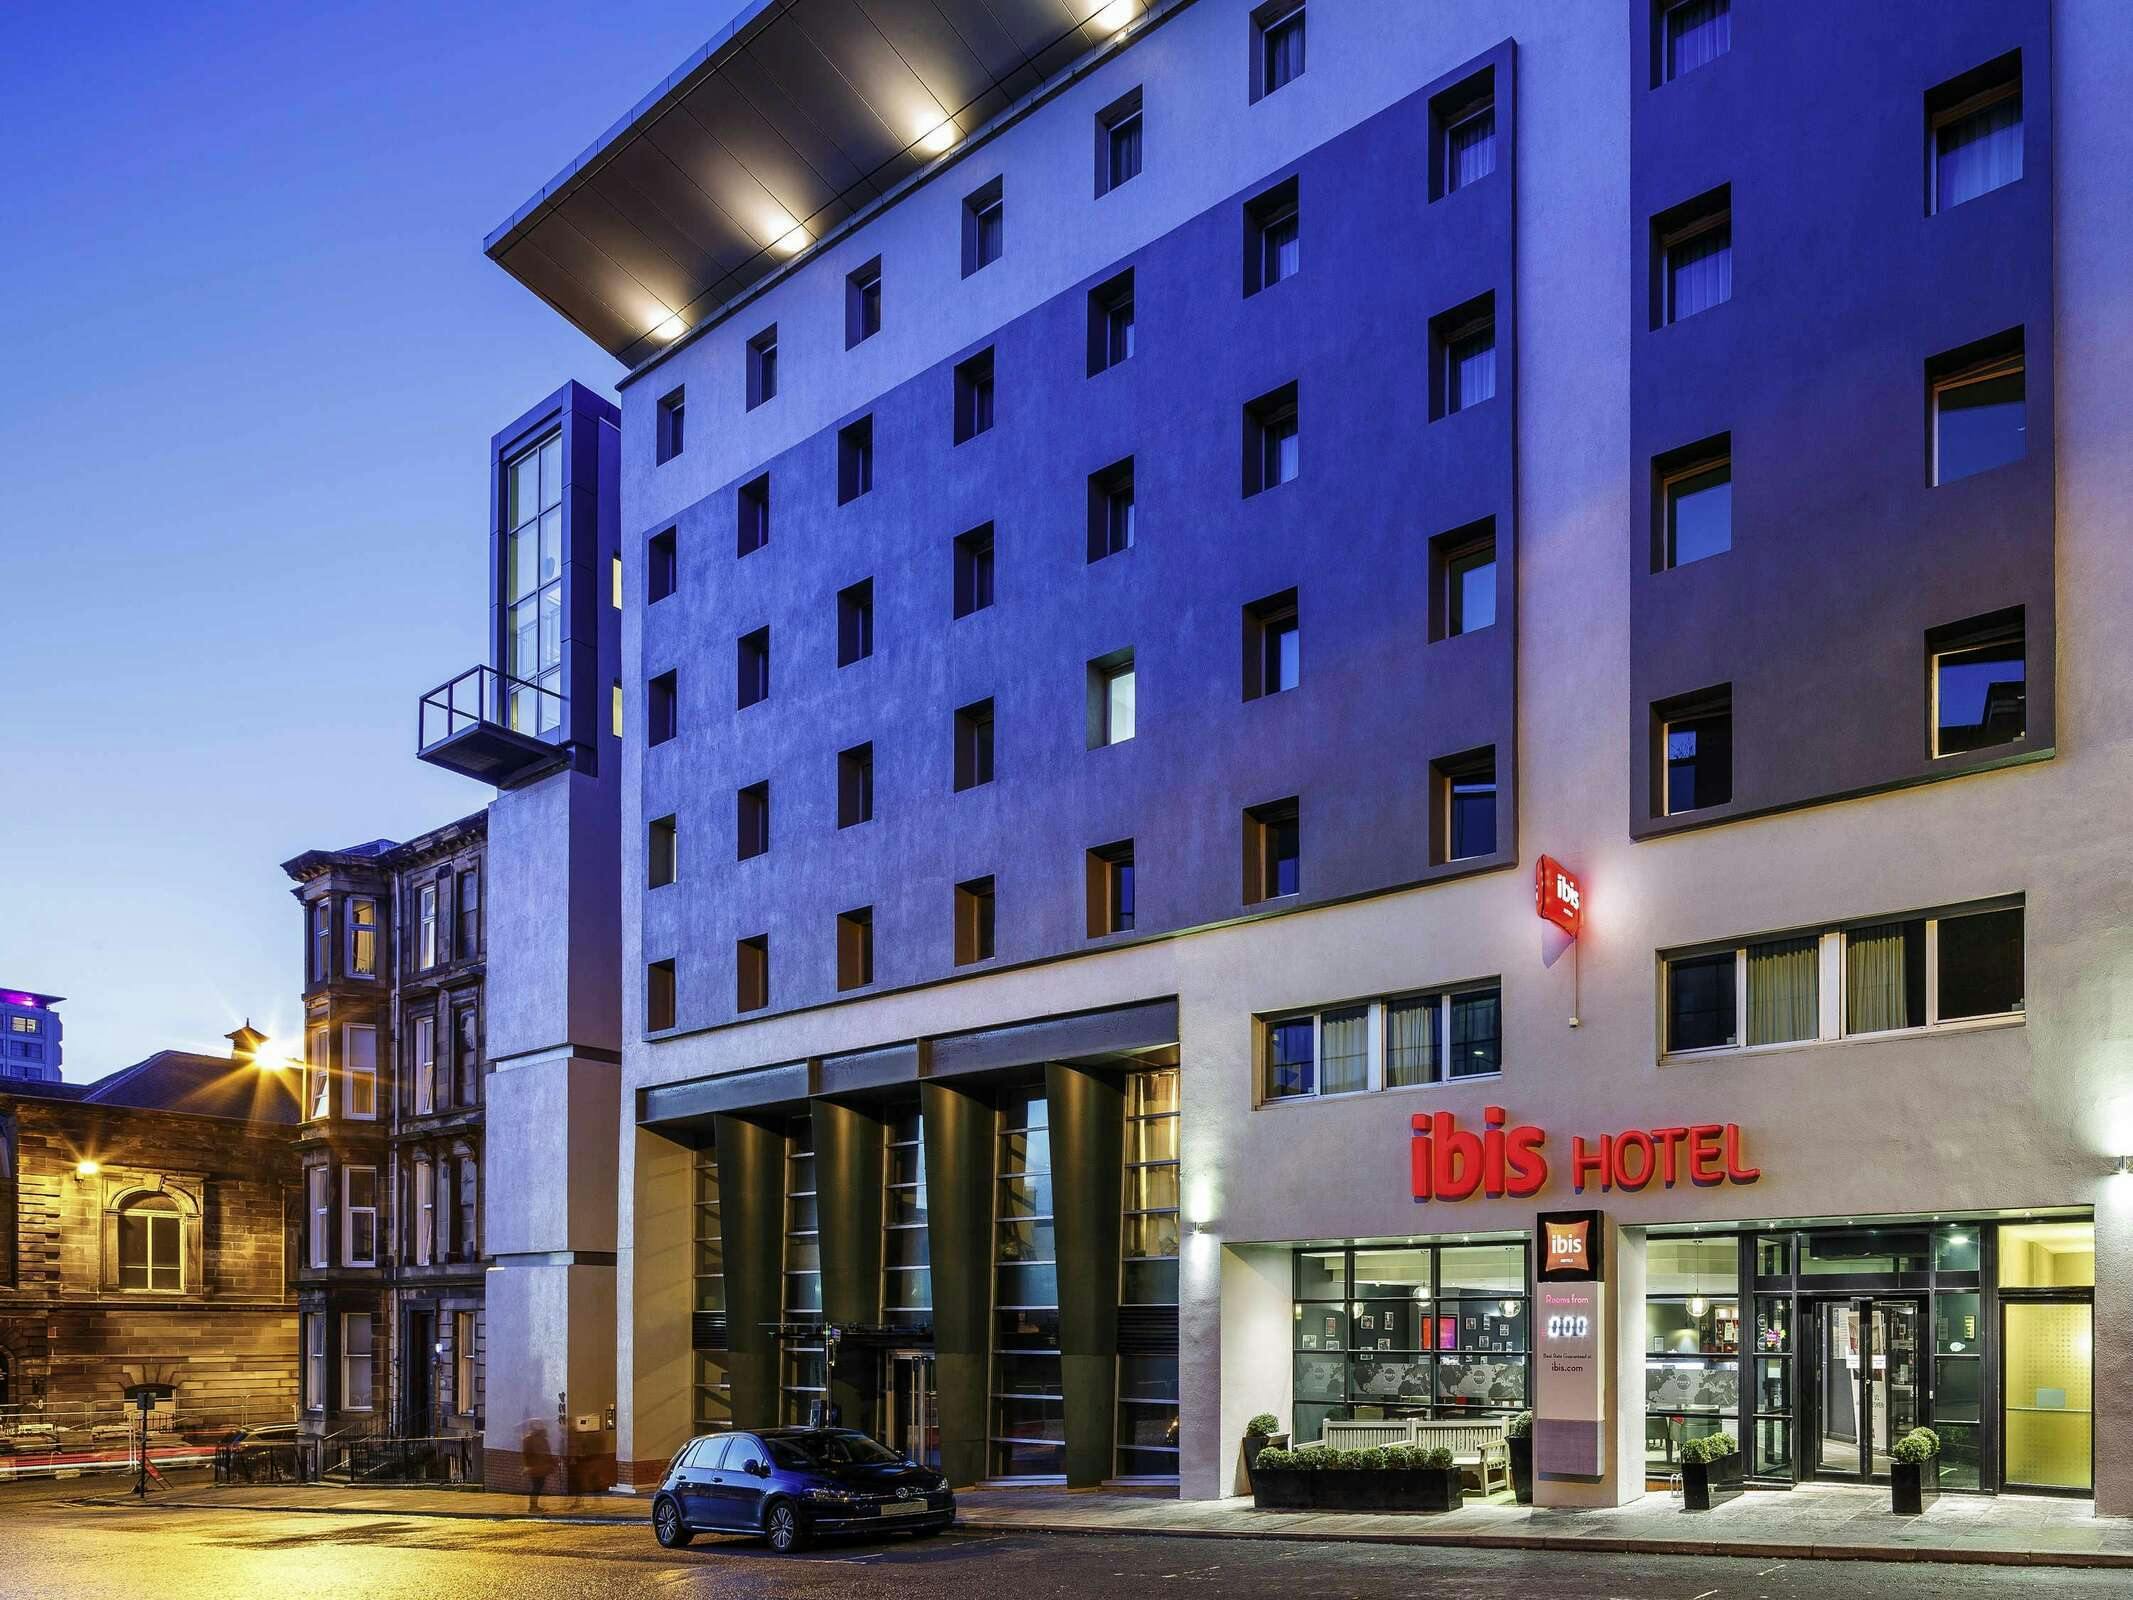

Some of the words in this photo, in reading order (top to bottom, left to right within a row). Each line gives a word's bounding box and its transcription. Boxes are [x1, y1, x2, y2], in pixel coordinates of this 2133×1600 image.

[1557, 873, 1580, 910] ibis
[1411, 1105, 1548, 1203] ibis
[1572, 1123, 1761, 1194] HOTEL
[1551, 1233, 1582, 1254] ibis
[1545, 1294, 1570, 1304] Rooms
[1571, 1293, 1589, 1304] from
[1551, 1360, 1583, 1372] ibis.com
